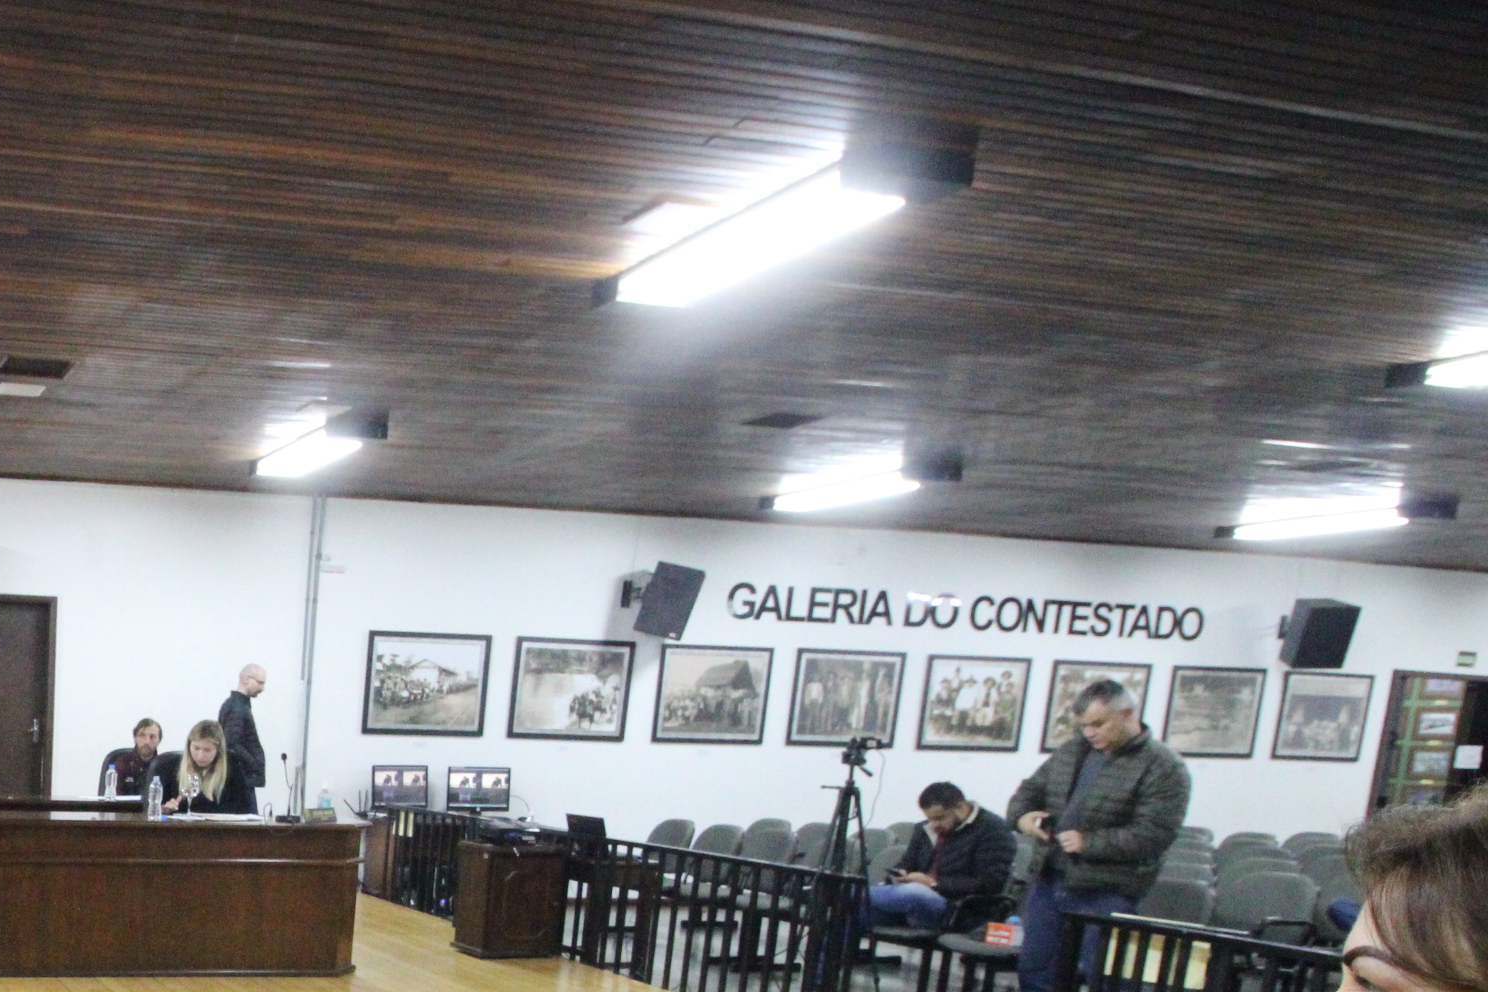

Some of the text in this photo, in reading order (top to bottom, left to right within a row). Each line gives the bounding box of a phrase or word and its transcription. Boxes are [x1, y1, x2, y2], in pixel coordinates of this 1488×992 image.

[727, 582, 1204, 641] GALERIA DO CONTESTADO
